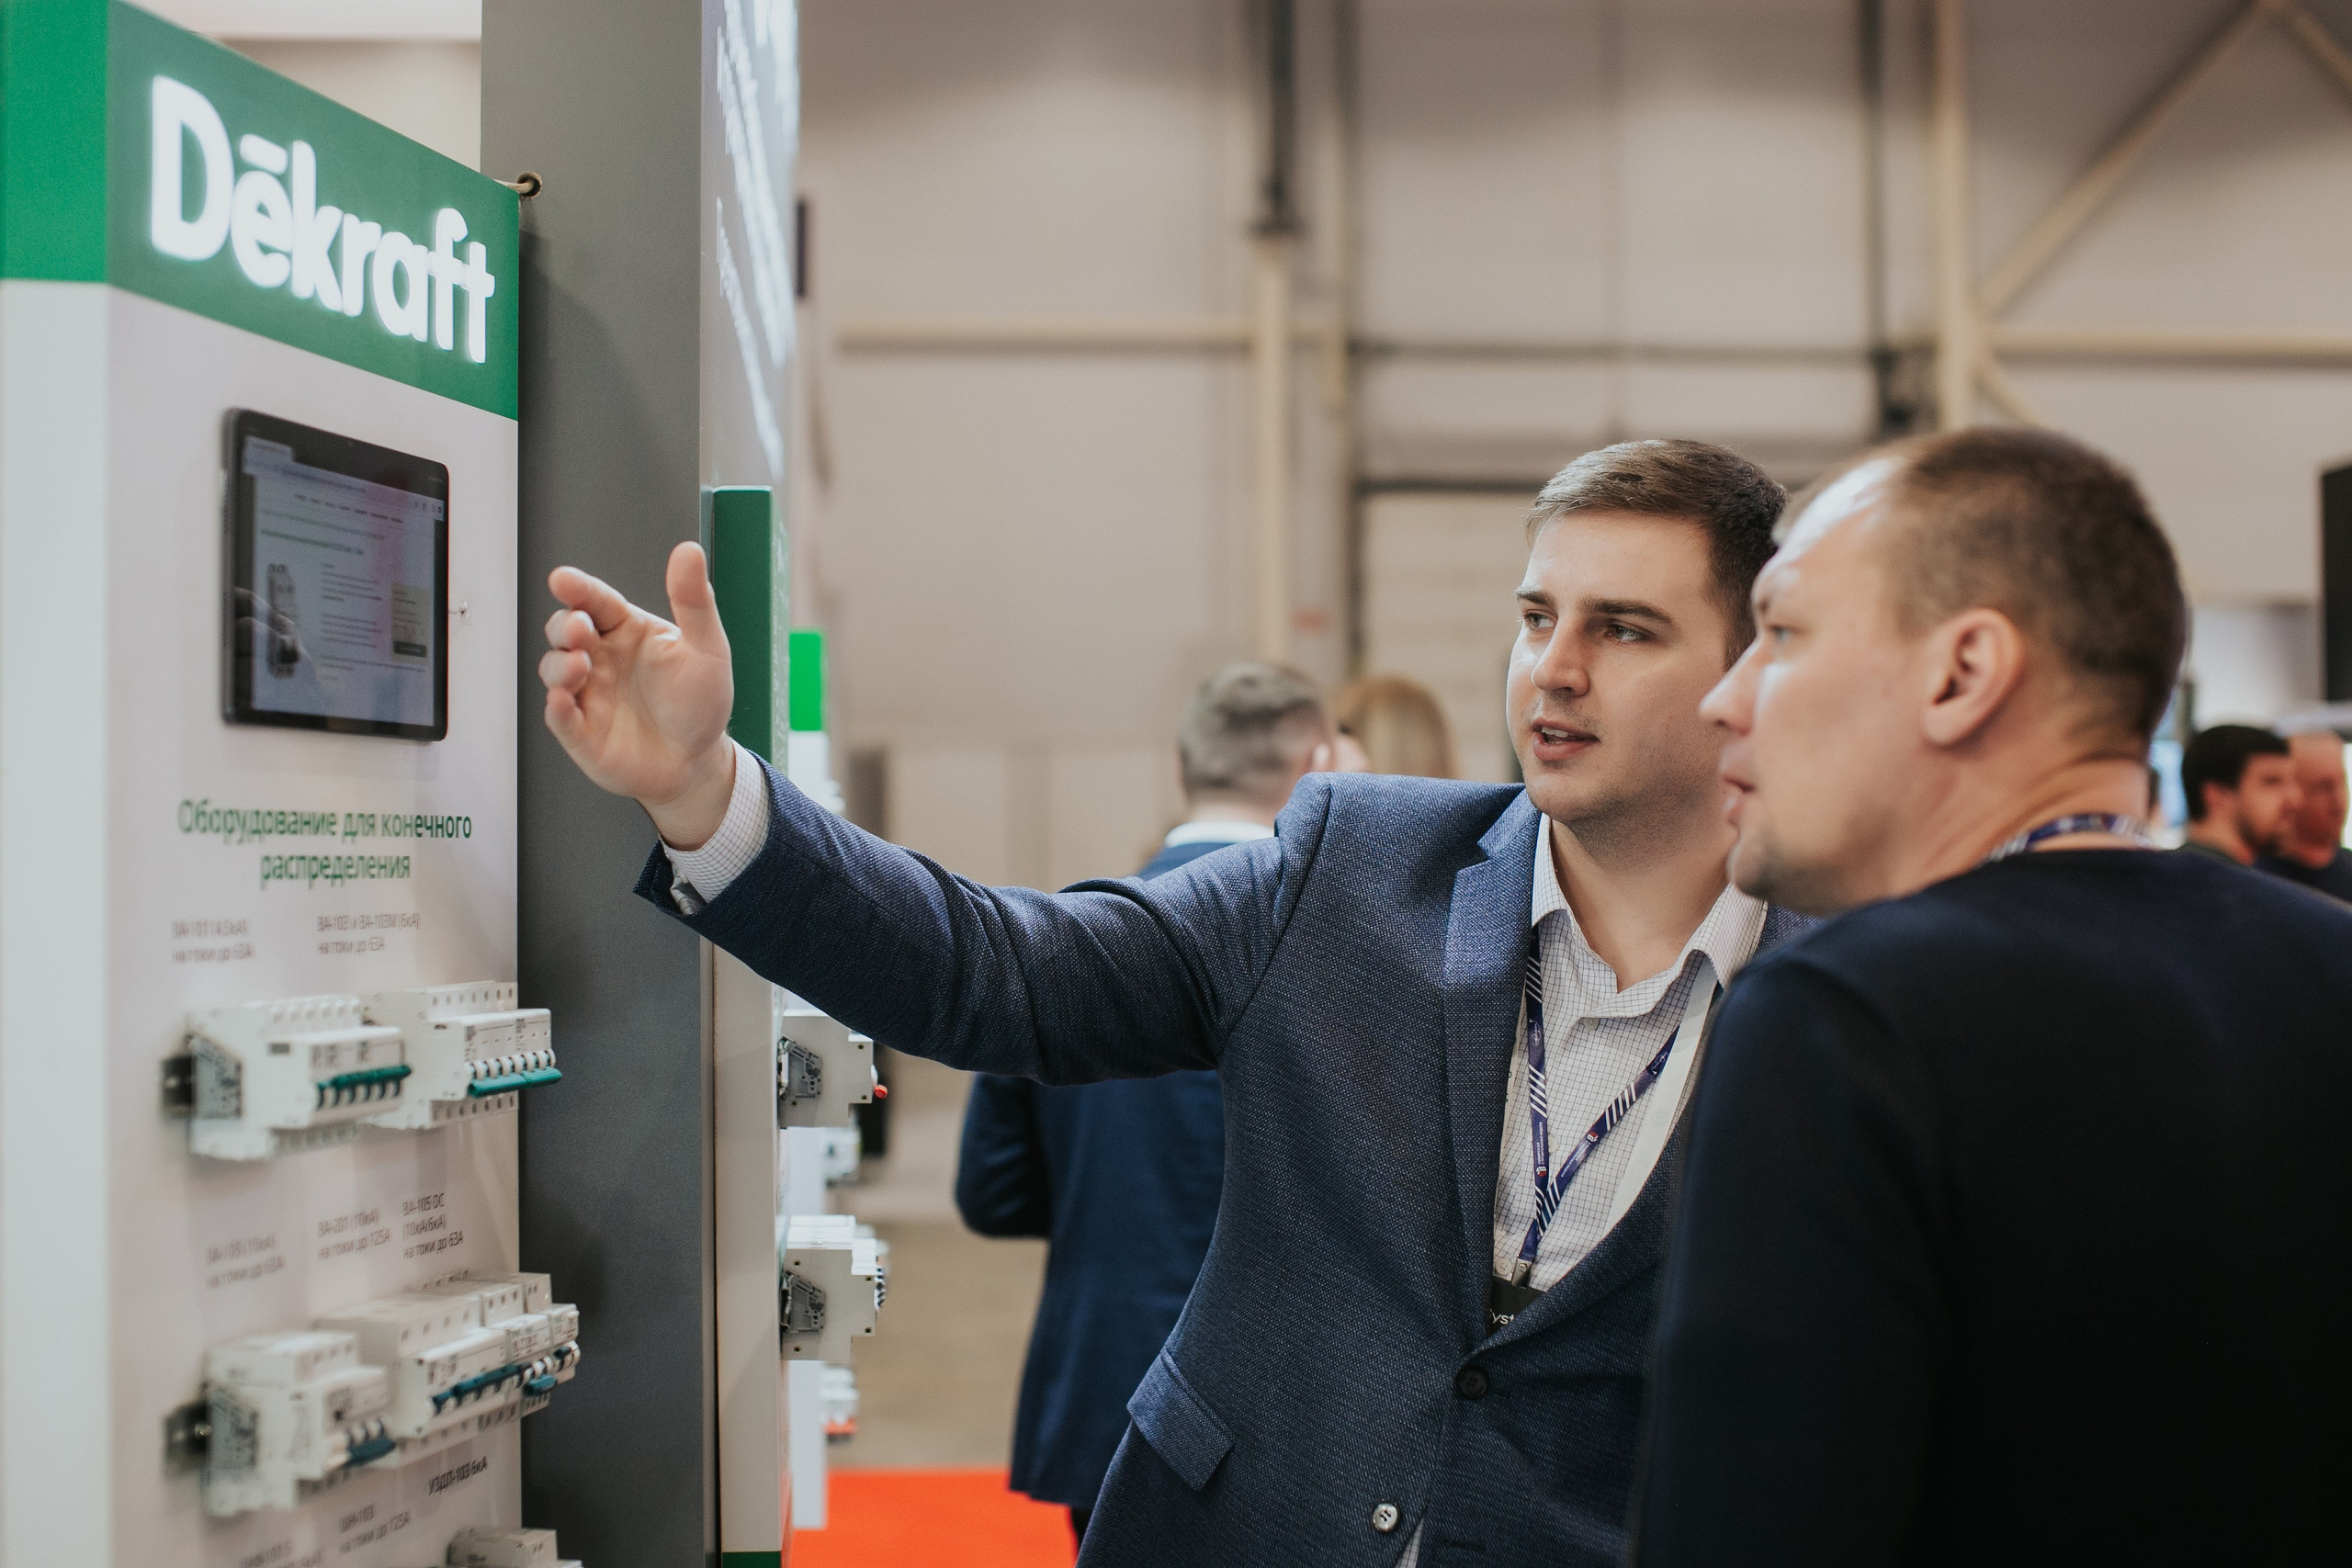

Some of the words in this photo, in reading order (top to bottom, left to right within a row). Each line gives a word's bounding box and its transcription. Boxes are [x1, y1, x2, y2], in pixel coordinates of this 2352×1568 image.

[178, 798, 337, 845] Оборудование
[341, 812, 377, 844] для
[380, 813, 472, 839] конечного
[259, 855, 411, 890] распределения
[331, 942, 353, 953] токи
[355, 941, 367, 955] до
[368, 937, 385, 952] 63А
[432, 1192, 446, 1209] DC
[402, 1213, 447, 1240] (10кА/6кА)
[403, 1247, 413, 1259] на
[413, 1241, 435, 1257] токи
[436, 1237, 447, 1255] до
[448, 1231, 463, 1247] 63А
[428, 1462, 470, 1495] УЗДП-103
